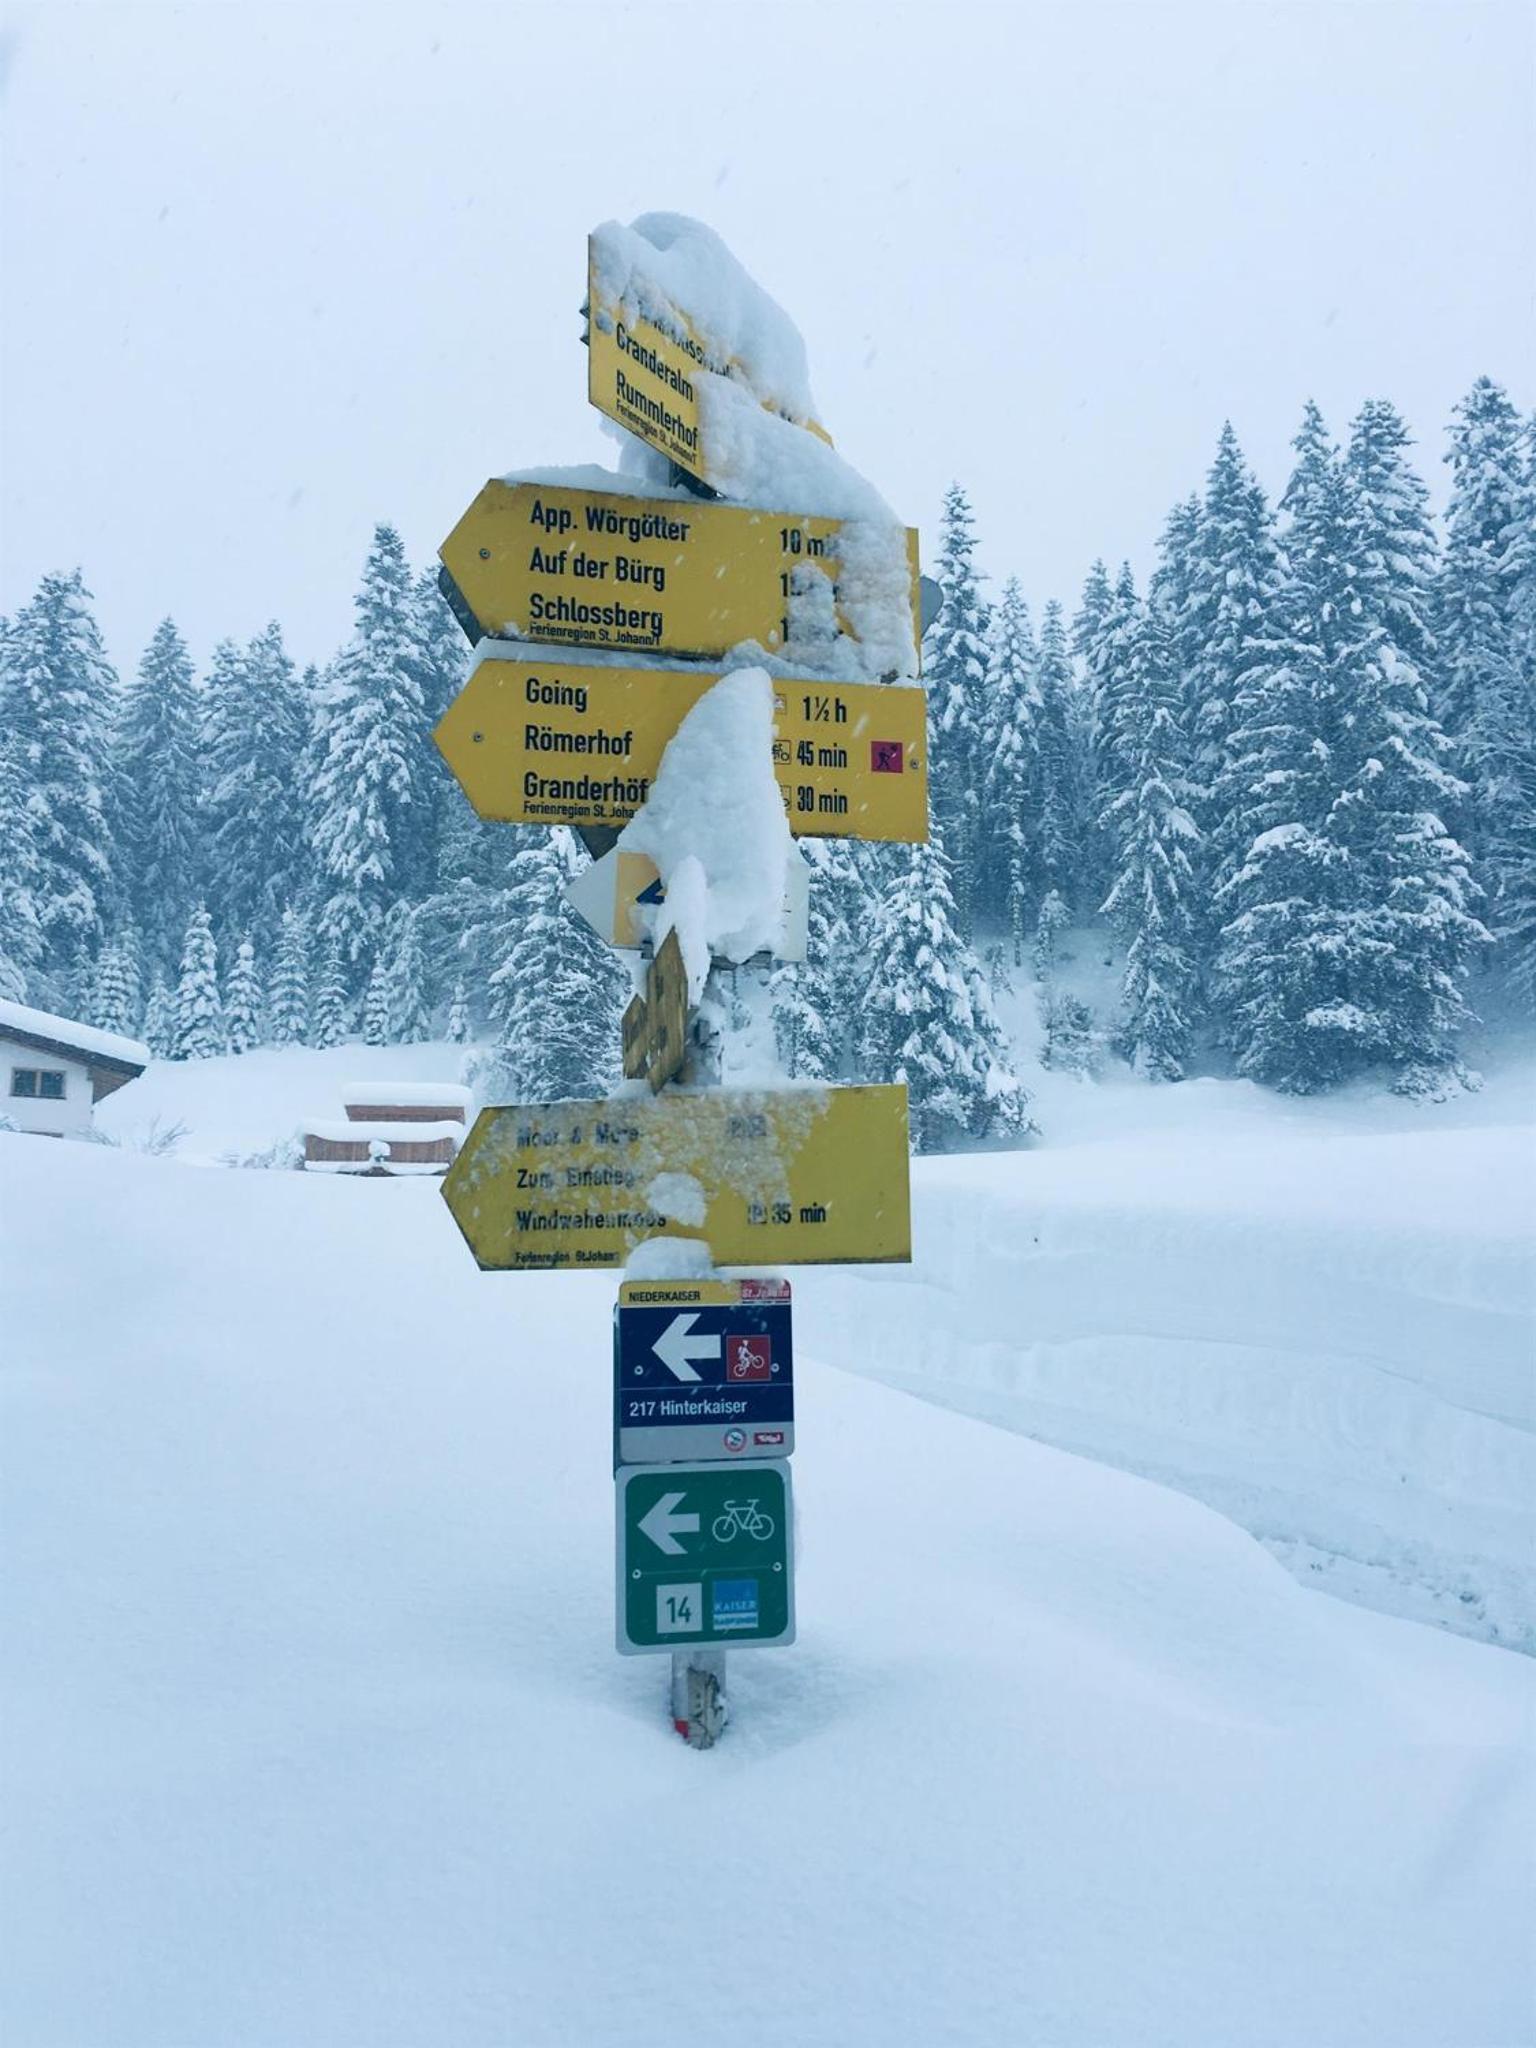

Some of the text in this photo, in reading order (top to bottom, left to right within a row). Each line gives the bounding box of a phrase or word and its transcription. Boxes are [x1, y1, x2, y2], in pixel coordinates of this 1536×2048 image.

[616, 369, 698, 450] Rummlerhof
[530, 500, 690, 543] App. Wörgötter
[780, 528, 801, 554] 10
[529, 547, 665, 592] Auf der Bürg
[529, 593, 663, 636] Schlossberg
[529, 622, 596, 641] Ferienregion
[526, 678, 588, 713] Going
[834, 698, 848, 723] h
[525, 724, 633, 756] Römerhof
[796, 740, 848, 768] 45 min
[523, 801, 591, 819] Ferienregion
[797, 786, 848, 813] 30 min
[771, 1202, 791, 1223] 35
[800, 1202, 826, 1223] min
[628, 1290, 700, 1302] NIEDERKAISER
[629, 1398, 748, 1417] 217 Hinterkaiser
[665, 1596, 691, 1623] 14
[714, 1600, 757, 1612] KAISER
